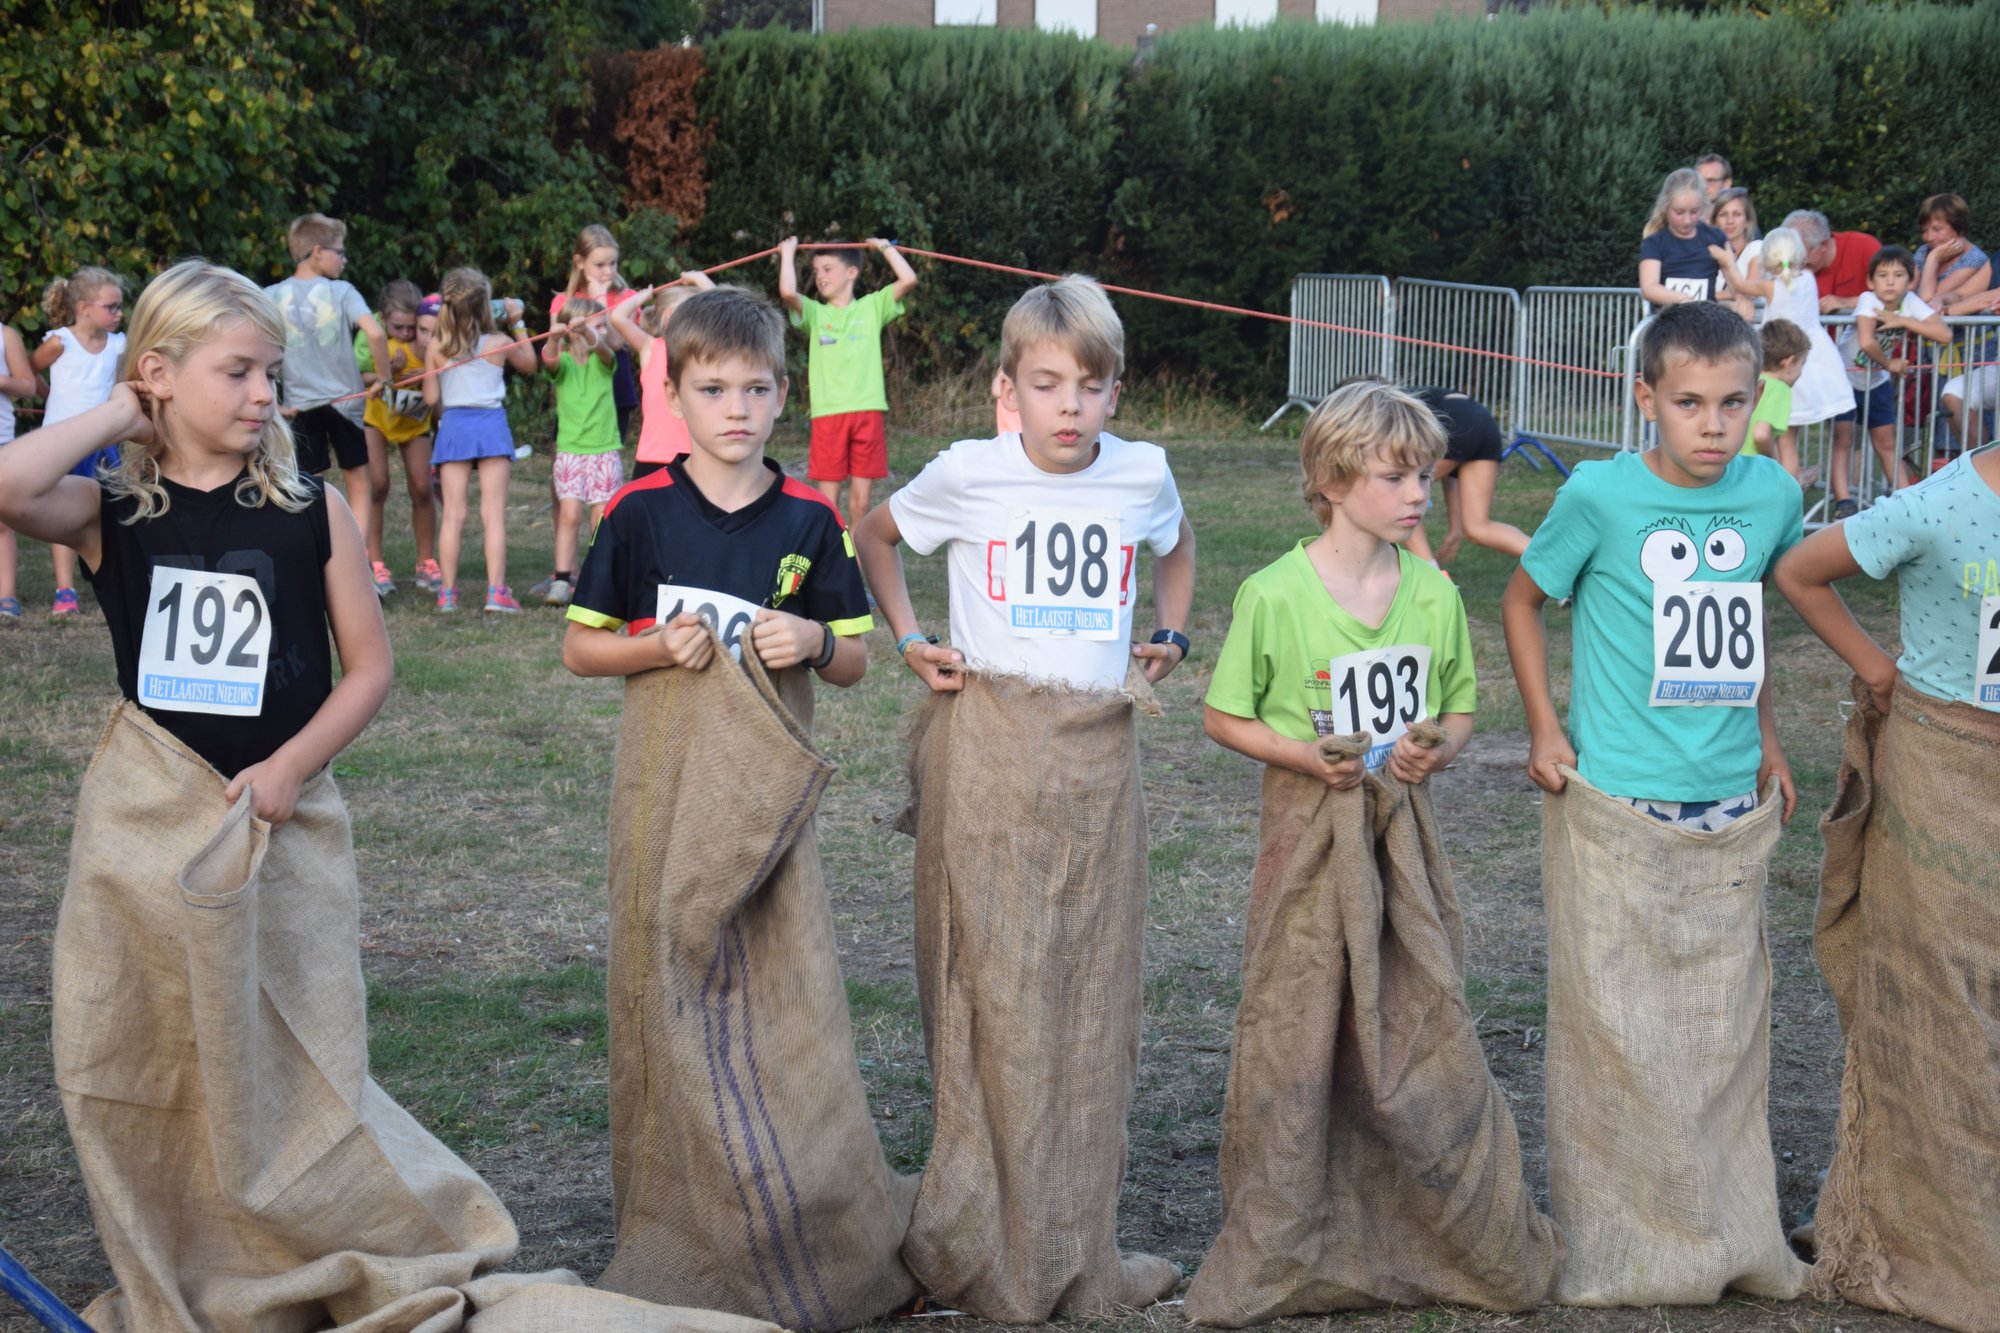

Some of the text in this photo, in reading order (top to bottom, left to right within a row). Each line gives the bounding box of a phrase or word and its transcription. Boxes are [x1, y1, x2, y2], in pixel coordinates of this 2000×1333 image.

[1015, 521, 1108, 599] 198
[157, 582, 262, 668] 192
[1016, 607, 1108, 629] HET LAATSTE NIEUWS
[1663, 594, 1754, 670] 208
[149, 677, 255, 705] HET LAATSTE NIEUWS
[1340, 655, 1419, 735] 193
[1660, 682, 1751, 700] HET LAATSTE NIEUWS
